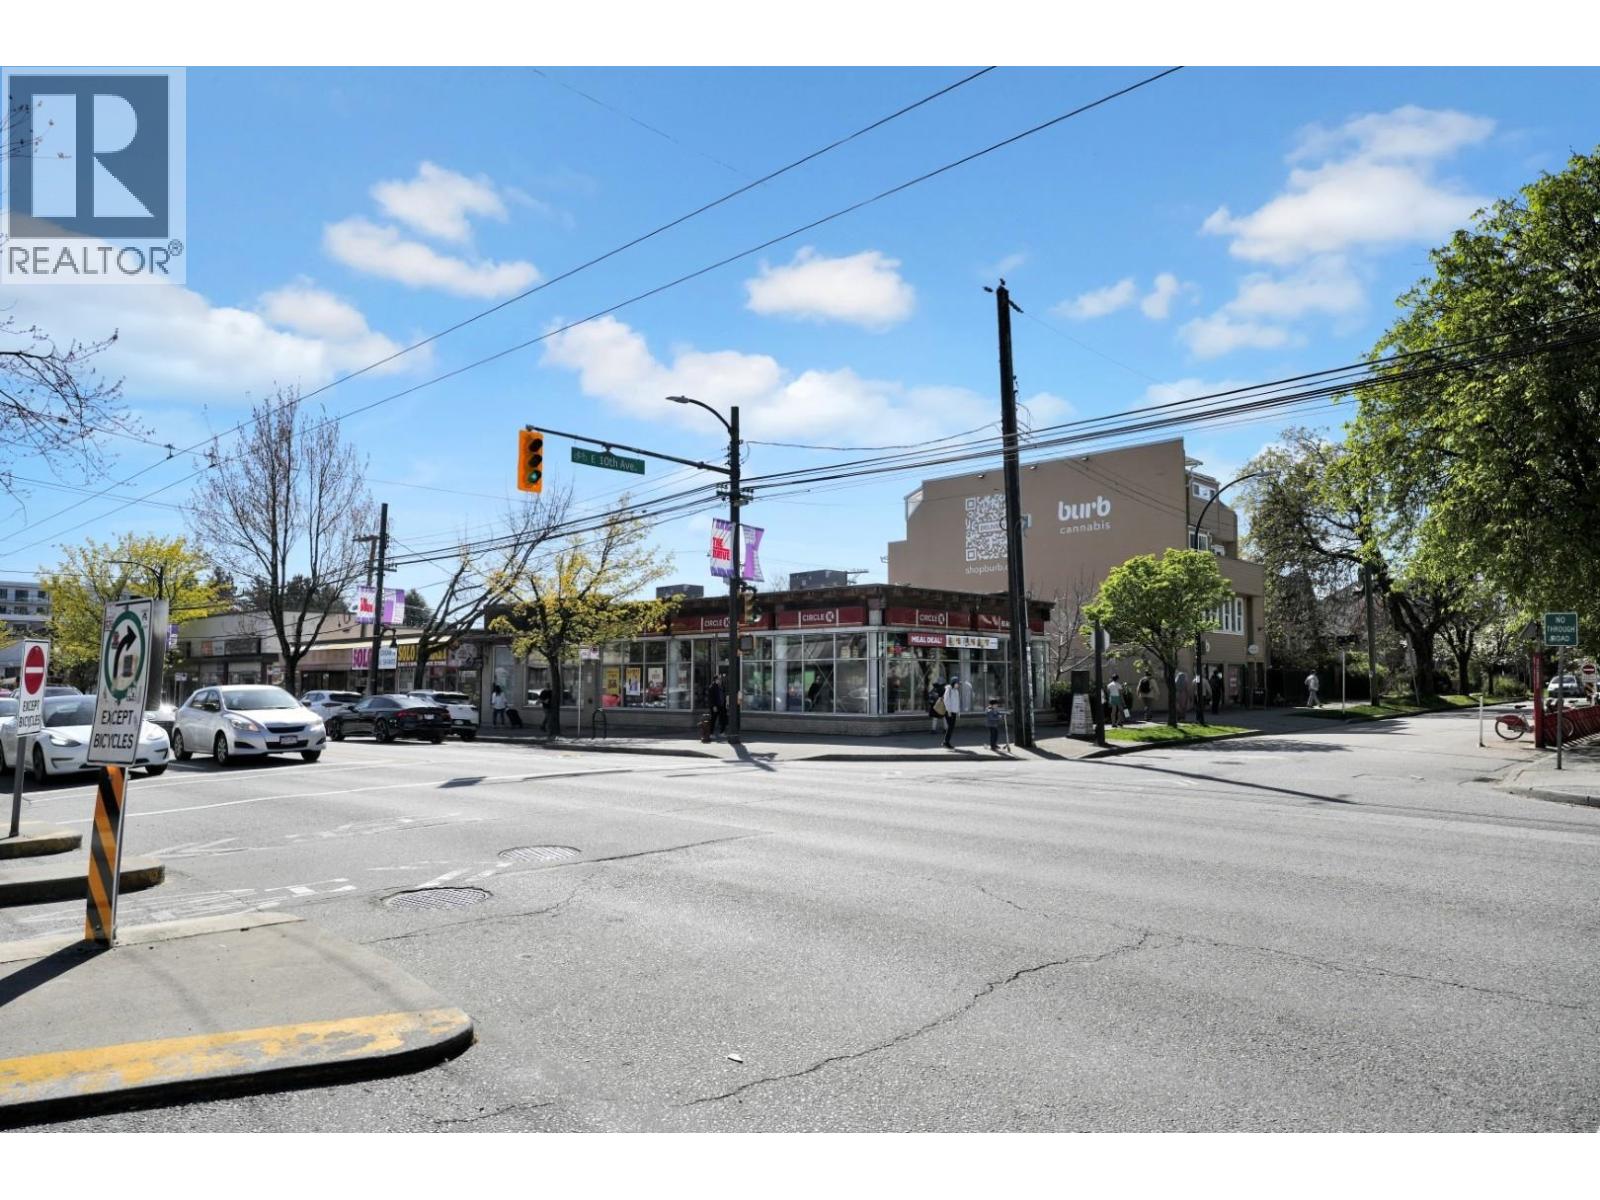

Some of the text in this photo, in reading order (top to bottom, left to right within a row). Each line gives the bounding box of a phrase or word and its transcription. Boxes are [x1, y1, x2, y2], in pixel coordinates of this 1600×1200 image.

[591, 455, 596, 464] E
[600, 456, 618, 468] 10th
[1058, 495, 1111, 522] burb
[1059, 520, 1111, 535] cannabis
[802, 610, 835, 622] CIRCLE K
[919, 613, 938, 623] CIRCLE
[1555, 616, 1566, 624] NO
[1547, 625, 1575, 633] THROUGH
[911, 635, 927, 643] MEAL
[22, 699, 40, 712] EXCEPT
[18, 715, 41, 728] BICYCLES
[101, 710, 134, 725] EXCEPT
[93, 734, 134, 749] BICYCLES
